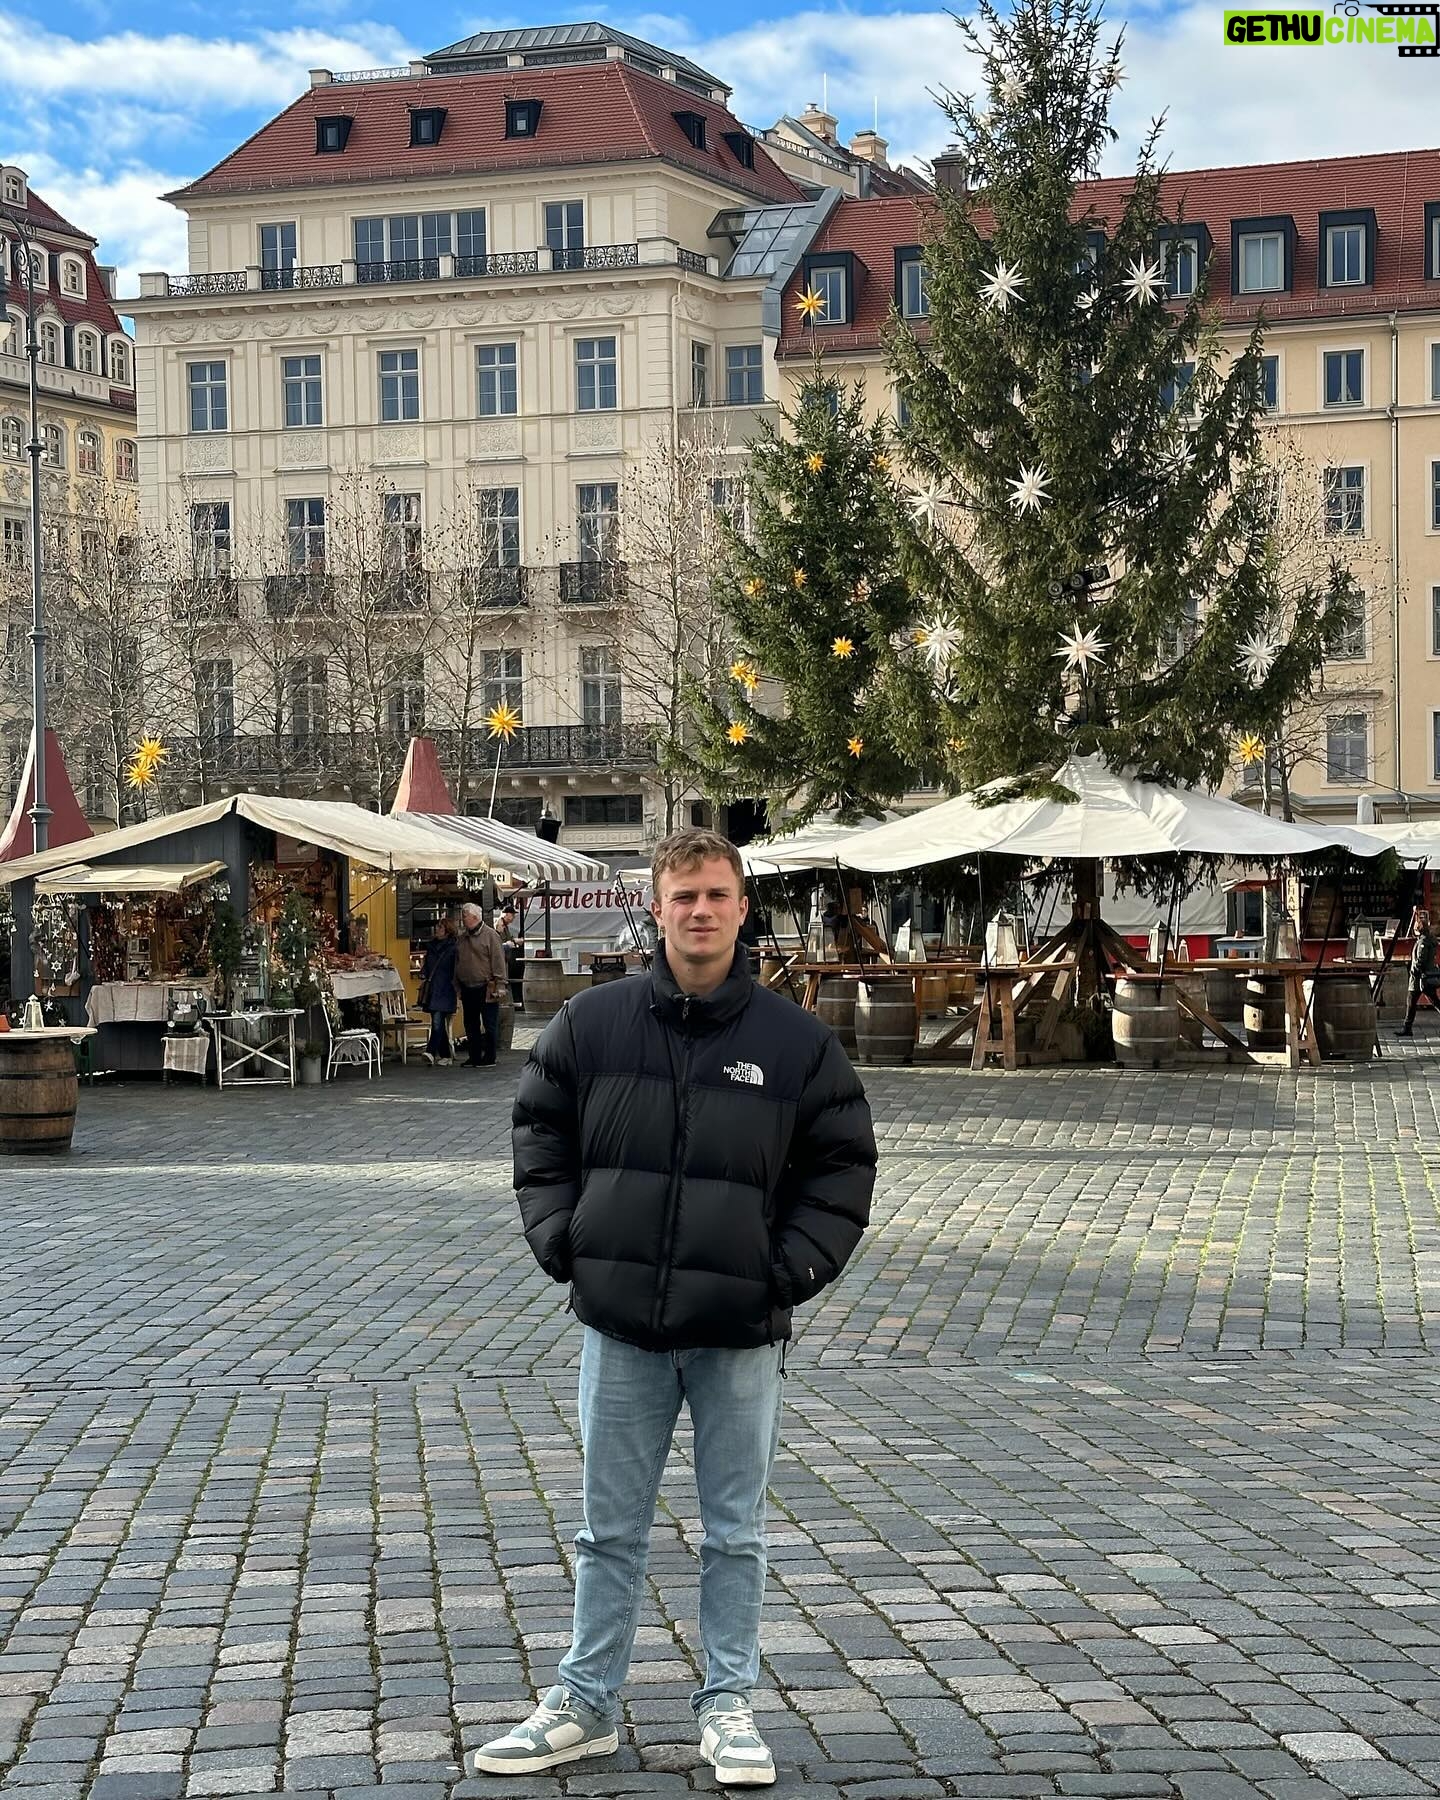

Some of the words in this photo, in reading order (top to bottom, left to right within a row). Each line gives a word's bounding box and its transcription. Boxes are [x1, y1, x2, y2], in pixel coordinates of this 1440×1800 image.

[736, 1061, 752, 1070] THE
[723, 1066, 751, 1078] NORTH
[730, 1073, 750, 1083] FACE
